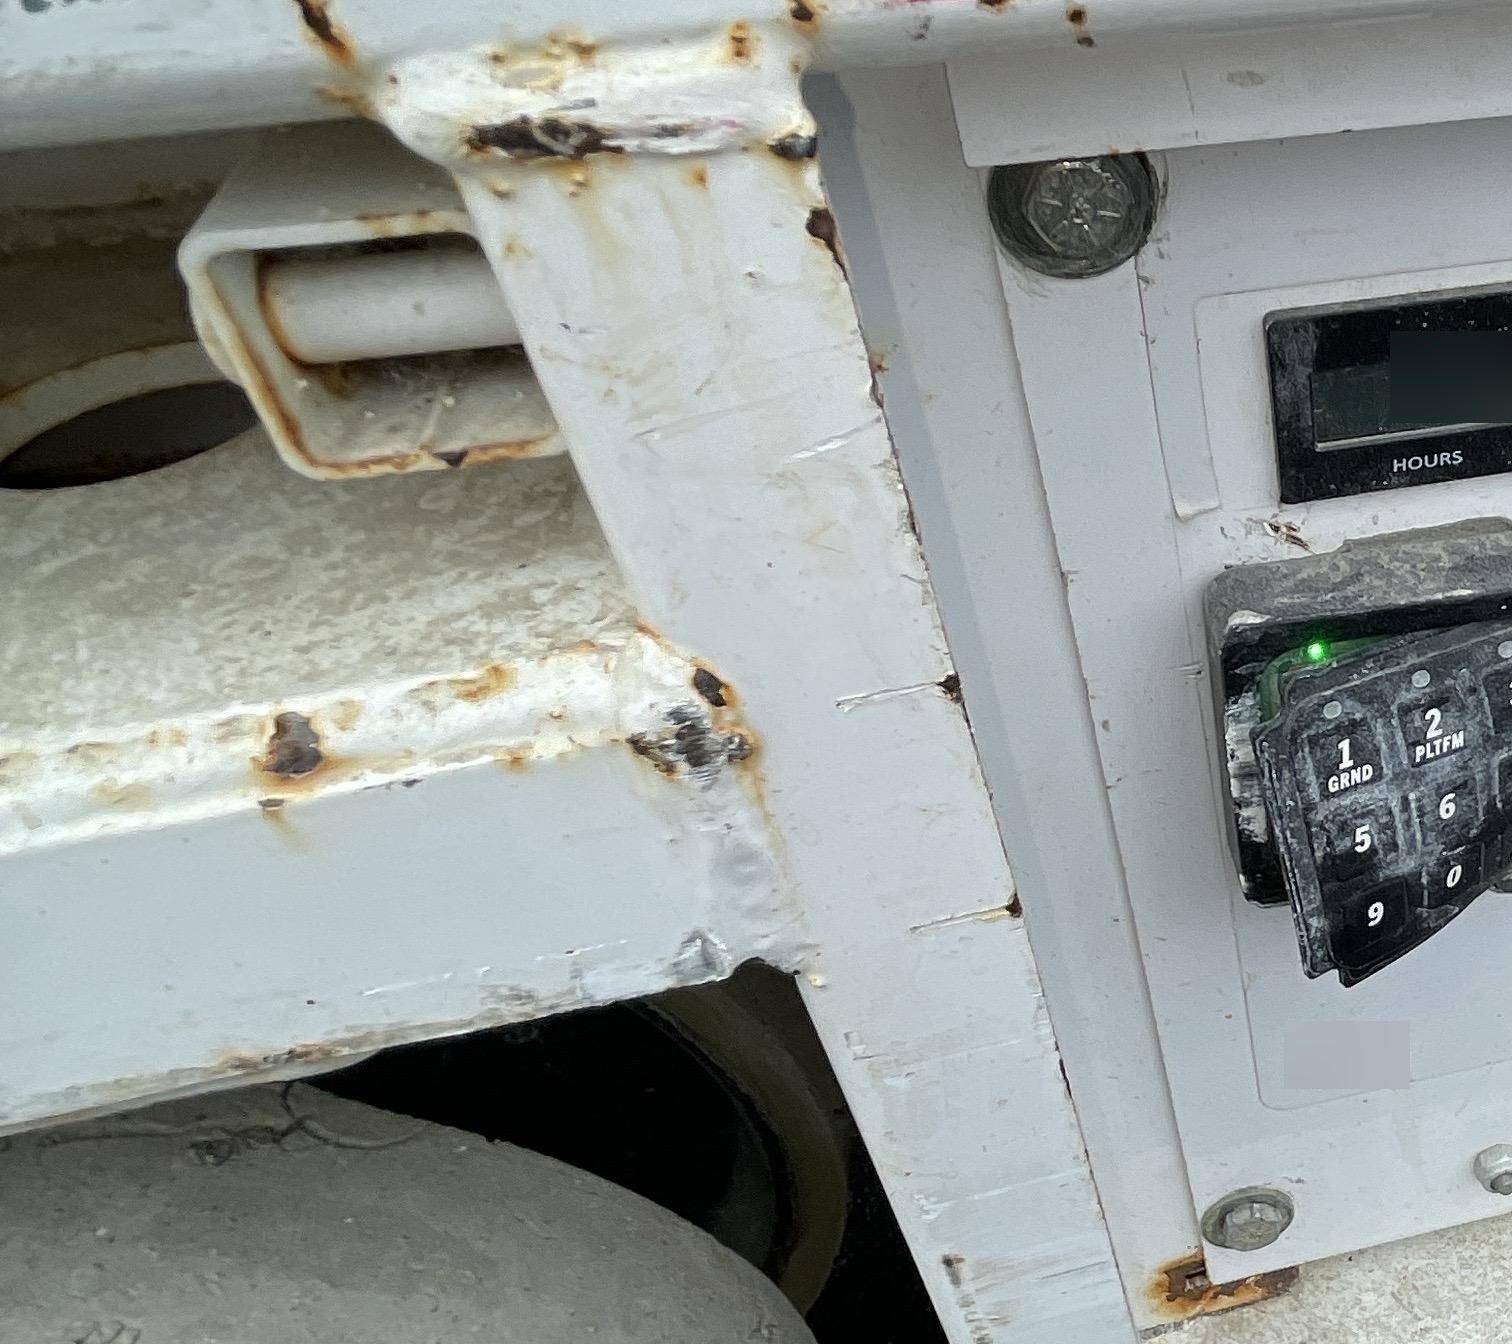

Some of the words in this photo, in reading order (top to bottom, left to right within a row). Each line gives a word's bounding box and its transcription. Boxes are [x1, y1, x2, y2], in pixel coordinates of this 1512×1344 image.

[1392, 450, 1464, 473] HOURS
[1424, 707, 1443, 740] 2
[1337, 738, 1354, 770] 1
[1415, 730, 1465, 763] PLTFM
[1327, 763, 1374, 794] GRND
[1438, 792, 1456, 820] 6
[1353, 823, 1372, 854] 5
[1446, 864, 1463, 889] 0
[1367, 900, 1385, 928] 9
